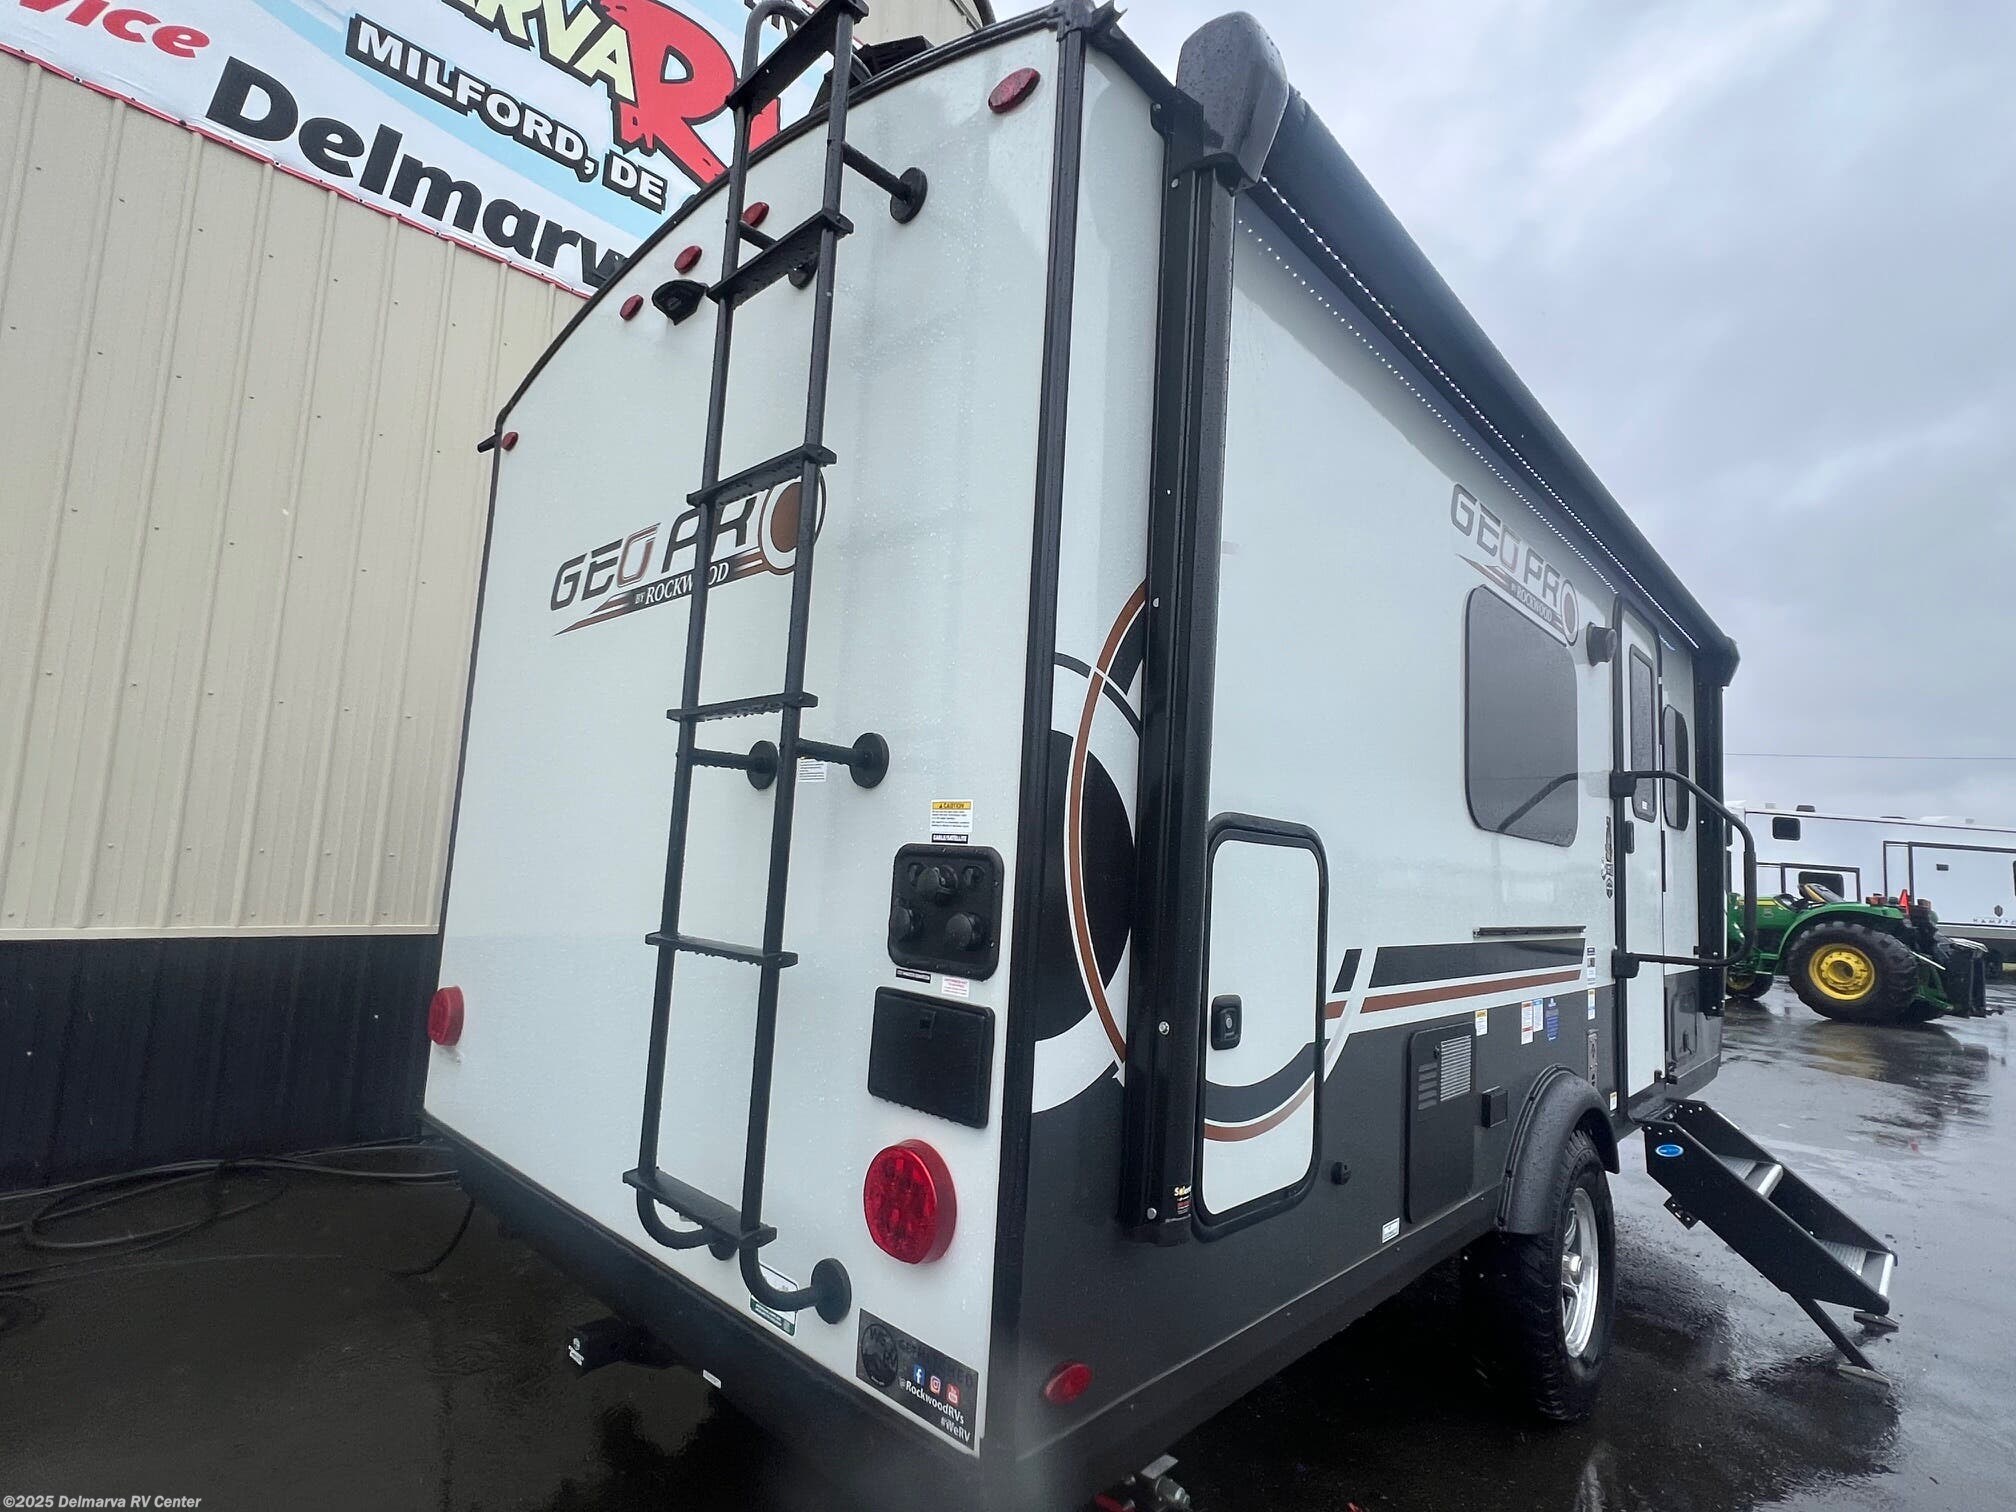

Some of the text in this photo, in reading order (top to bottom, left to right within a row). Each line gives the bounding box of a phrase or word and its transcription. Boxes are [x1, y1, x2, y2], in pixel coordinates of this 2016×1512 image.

[347, 15, 667, 213] MILFORD, DE
[550, 523, 661, 611] GEO
[645, 562, 730, 605] ROCKWOD
[1450, 483, 1579, 647] GEO PRO
